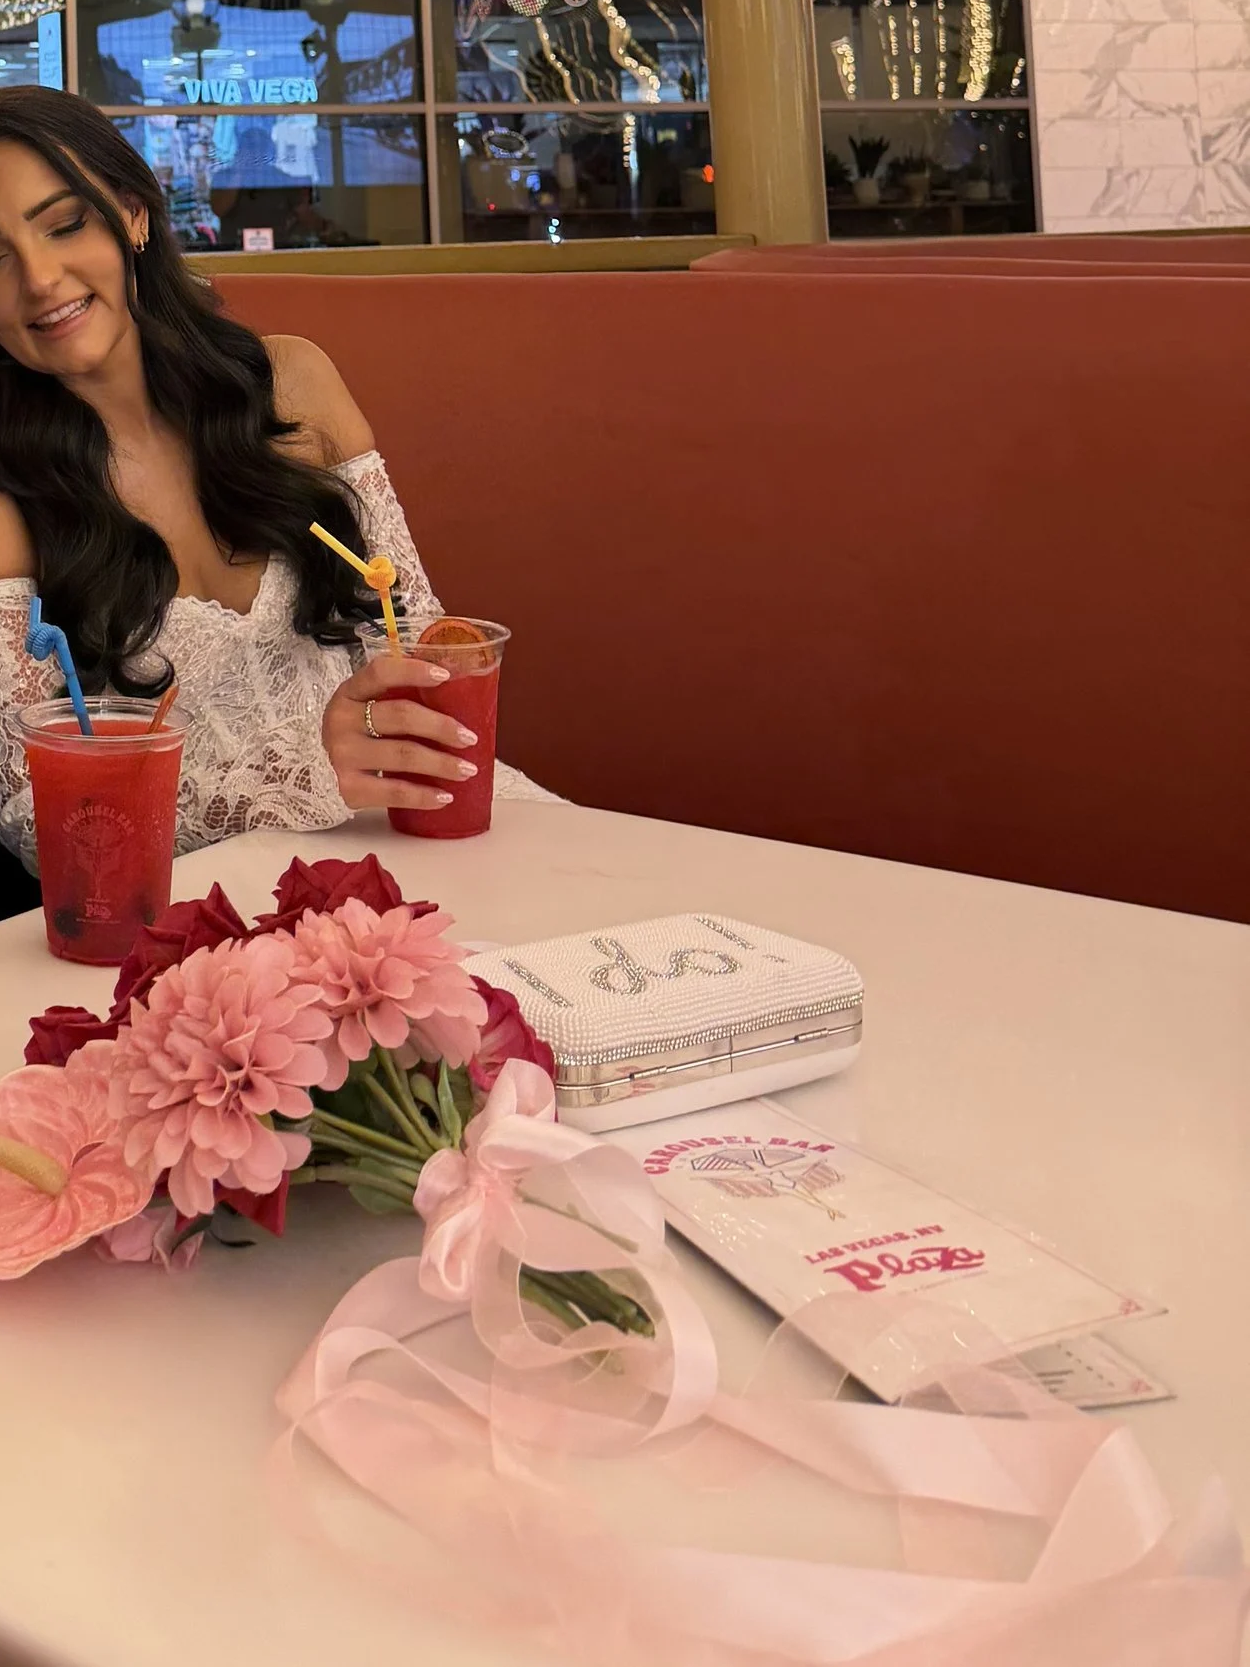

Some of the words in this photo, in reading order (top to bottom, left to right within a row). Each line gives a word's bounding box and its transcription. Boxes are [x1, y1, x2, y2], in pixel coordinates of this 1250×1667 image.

[184, 79, 242, 104] VIVA
[643, 1136, 760, 1175] CAROUSEL
[768, 1136, 835, 1154] BAR
[804, 1247, 846, 1265] LAS
[913, 1224, 946, 1237] NV
[823, 1246, 986, 1293] Plaza
